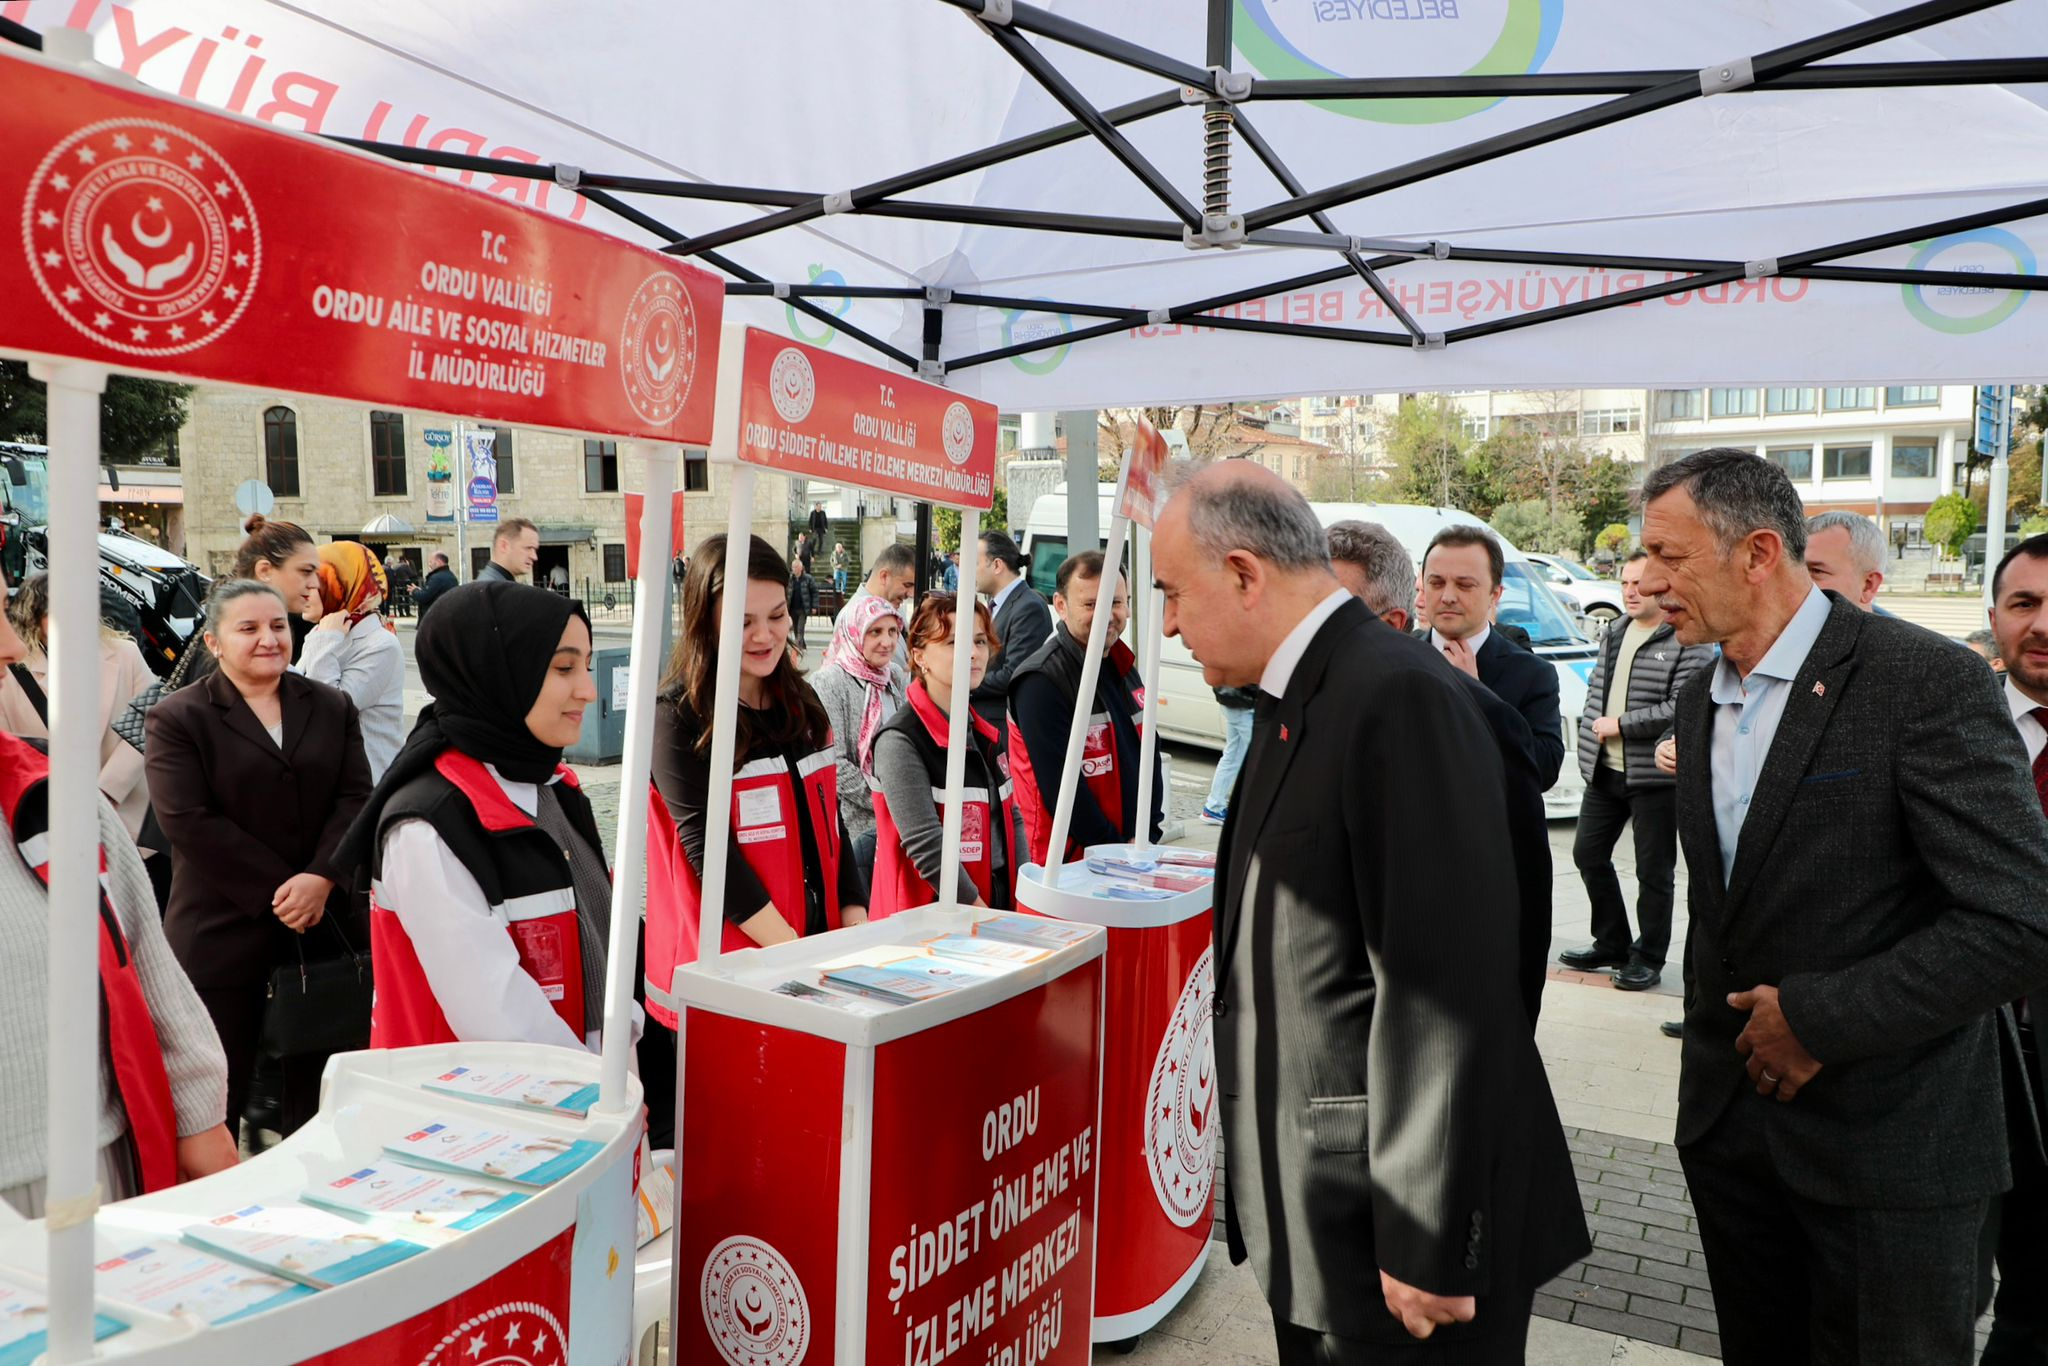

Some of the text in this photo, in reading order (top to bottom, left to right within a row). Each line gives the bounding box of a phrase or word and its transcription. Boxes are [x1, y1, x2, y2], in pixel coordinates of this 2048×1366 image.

[138, 162, 157, 176] VE
[481, 230, 508, 264] T.C.
[421, 261, 552, 317] ORDU VALİLİĞİ
[312, 285, 383, 326] ORDU
[387, 295, 432, 337] AİLE
[438, 313, 463, 342] VE
[465, 315, 528, 354] SOSYAL
[533, 325, 607, 368] HİZMETLER
[408, 342, 546, 398] İL MÜDÜRLÜĞÜ
[879, 384, 896, 408] T.C.
[853, 412, 878, 438] ORDU
[880, 418, 917, 449] VALİLİĞİ
[746, 421, 991, 498] ORDU ŞİDDET ÖNLEME VE İZLEME MERKEZİ MÜDÜRLÜĞÜ
[98, 573, 144, 610] ROMEK
[982, 1085, 1040, 1162] ORDU
[888, 1125, 1091, 1315] ŞİDDET ÖNLEME VE
[740, 1266, 763, 1279] SOSYAL
[905, 1196, 1081, 1366] İZLEME MERKEZİ
